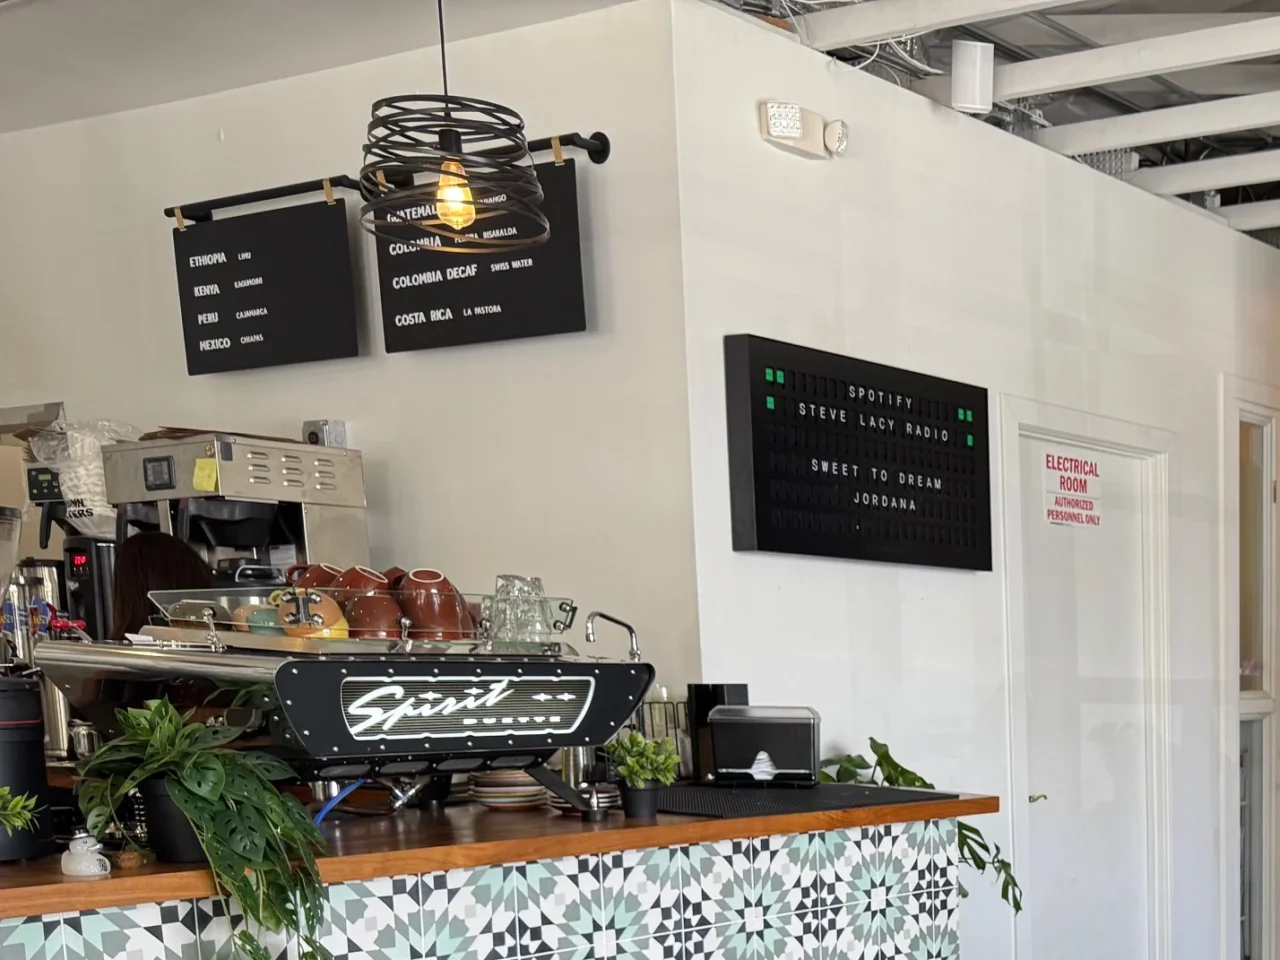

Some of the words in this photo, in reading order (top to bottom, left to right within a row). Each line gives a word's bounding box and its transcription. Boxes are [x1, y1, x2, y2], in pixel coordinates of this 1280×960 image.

[387, 204, 438, 222] GUATEMAL
[189, 252, 227, 268] ETHIOPIA
[392, 270, 443, 289] COLOMBIA
[446, 264, 478, 280] DECAF
[490, 263, 509, 272] SWISS
[511, 258, 533, 268] WATER
[193, 284, 220, 297] KENYA
[198, 312, 219, 325] PERU
[235, 307, 268, 319] CAJAMARCA
[395, 312, 426, 327] COSTA
[430, 308, 453, 322] RICA
[463, 308, 472, 316] LA
[474, 305, 502, 315] PASTORA
[199, 338, 231, 351] MEXICO
[240, 334, 264, 344] CHIAPAS
[849, 385, 912, 409] SPOTIFY
[799, 402, 846, 422] STEVE
[859, 414, 894, 431] LACY
[906, 423, 948, 441] RADIO
[812, 458, 858, 477] SWEET
[871, 468, 888, 481] TO
[899, 472, 942, 489] DREAM
[1046, 454, 1099, 477] ELECTRICAL
[1060, 475, 1087, 494] ROOM
[853, 492, 916, 510] JORDANA
[1054, 496, 1094, 511] AUTHORIZED
[1047, 509, 1084, 524] PERSONNEL
[1085, 514, 1101, 526] ONLY
[348, 679, 515, 734] Spirit
